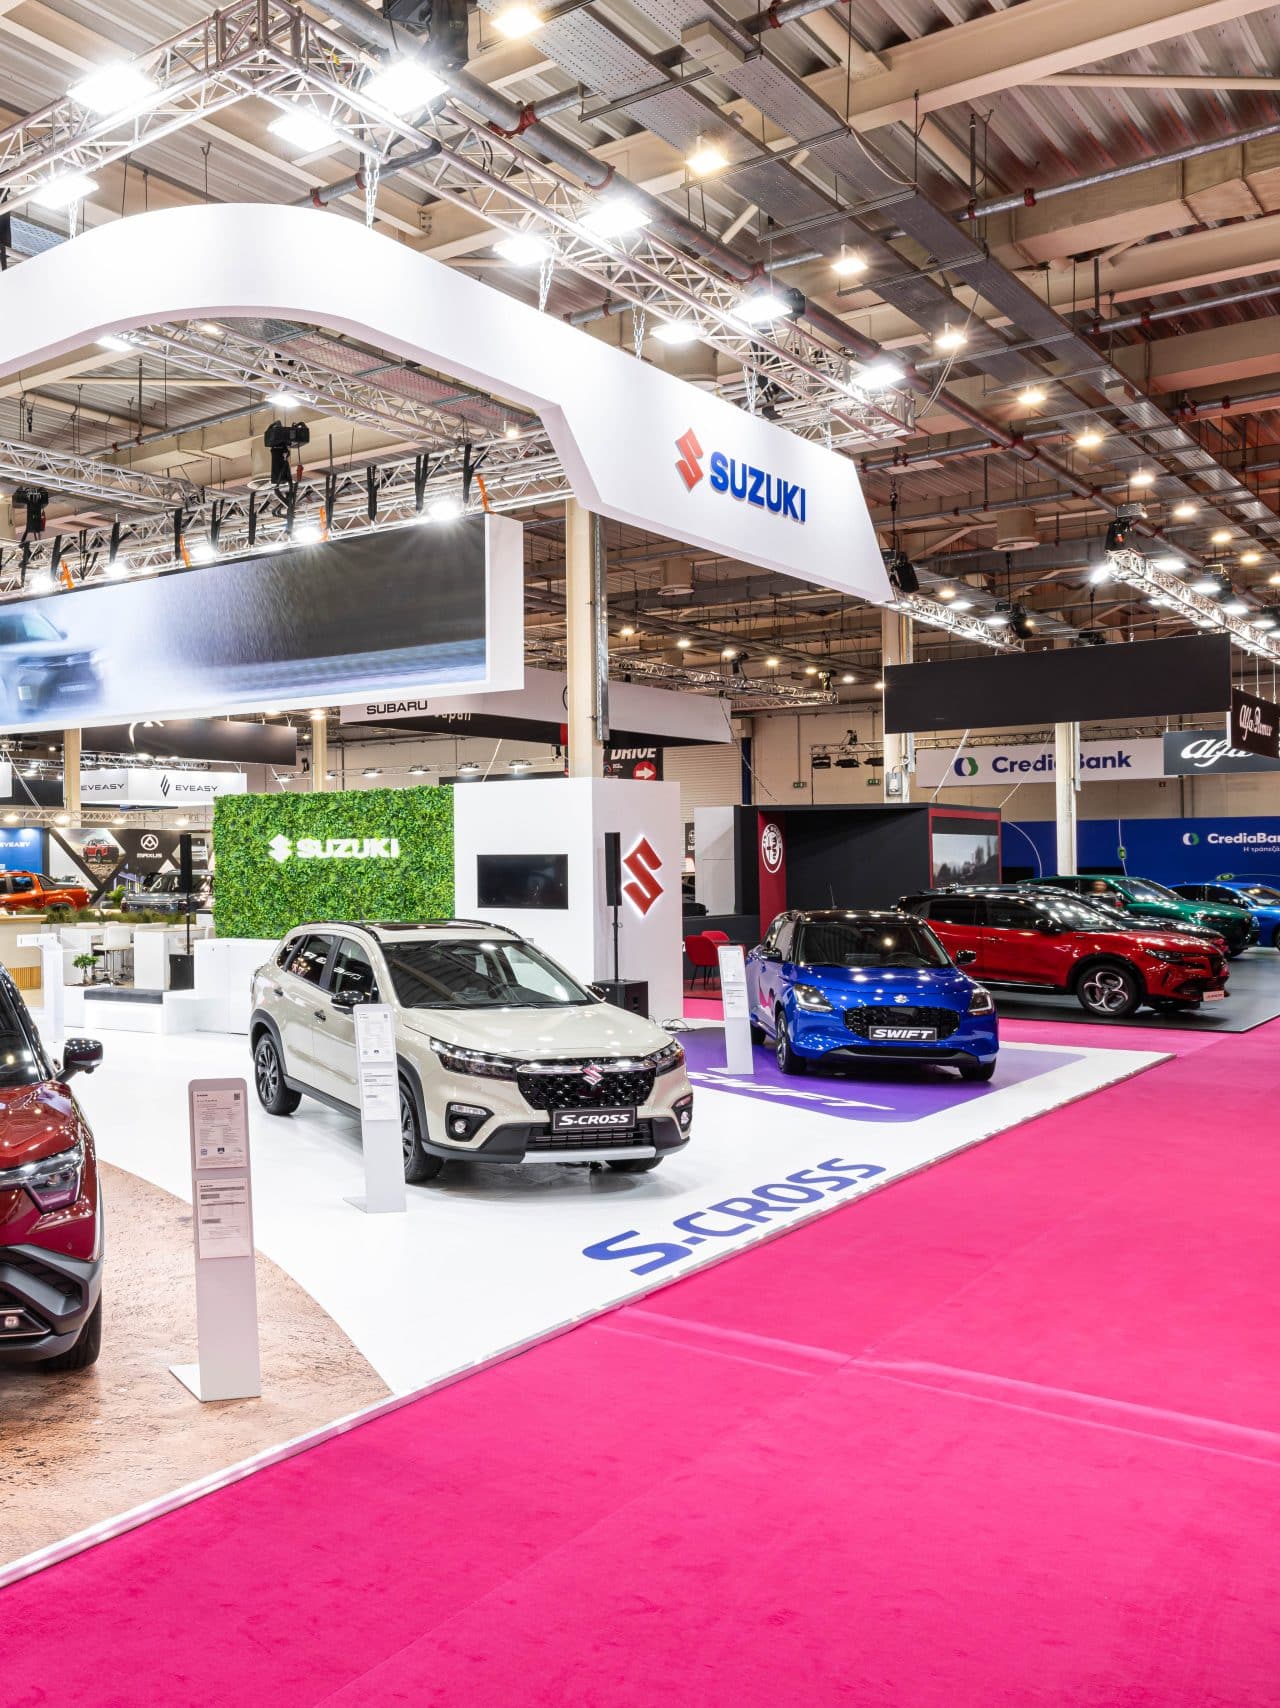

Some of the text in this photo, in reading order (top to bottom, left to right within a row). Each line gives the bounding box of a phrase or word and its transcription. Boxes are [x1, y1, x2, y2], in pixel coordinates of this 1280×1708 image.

[710, 451, 806, 523] SUZUKI
[366, 700, 428, 715] SUBARU
[991, 751, 1132, 773] Crediank
[81, 783, 125, 791] EVEASY
[175, 784, 218, 792] EVEASY
[296, 838, 399, 859] SUZUKI
[872, 1029, 933, 1039] SWIFT
